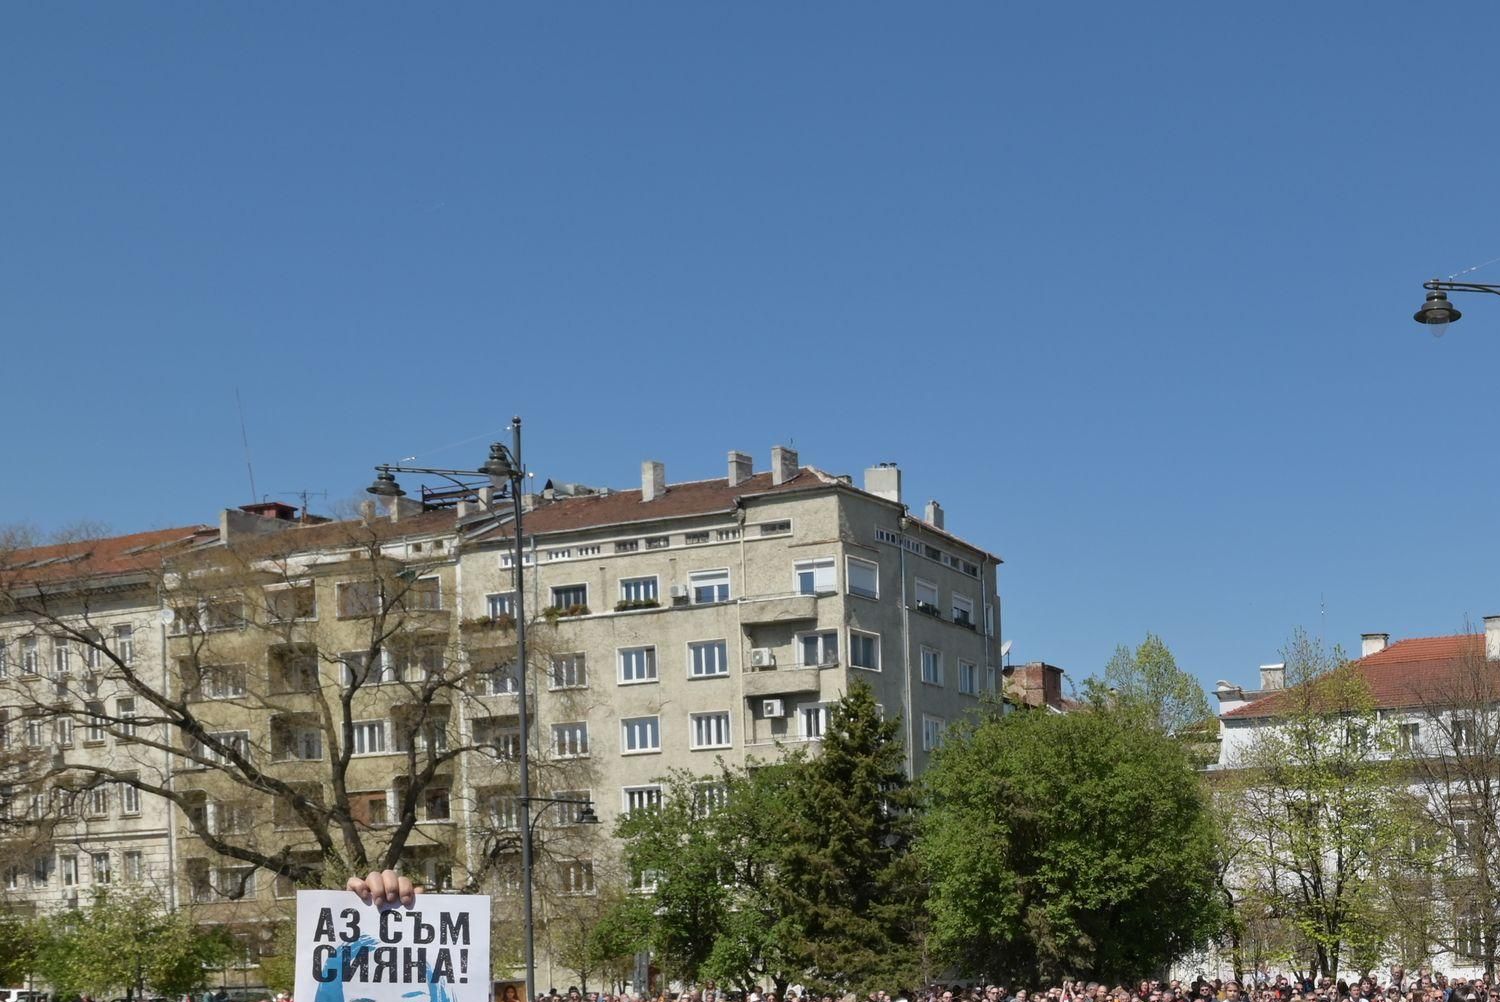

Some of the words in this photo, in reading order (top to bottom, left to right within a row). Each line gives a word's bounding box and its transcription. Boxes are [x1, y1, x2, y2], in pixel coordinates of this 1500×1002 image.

[314, 907, 361, 942] АЗ
[379, 909, 471, 945] СЪМ
[312, 944, 469, 984] СИЯНА!
